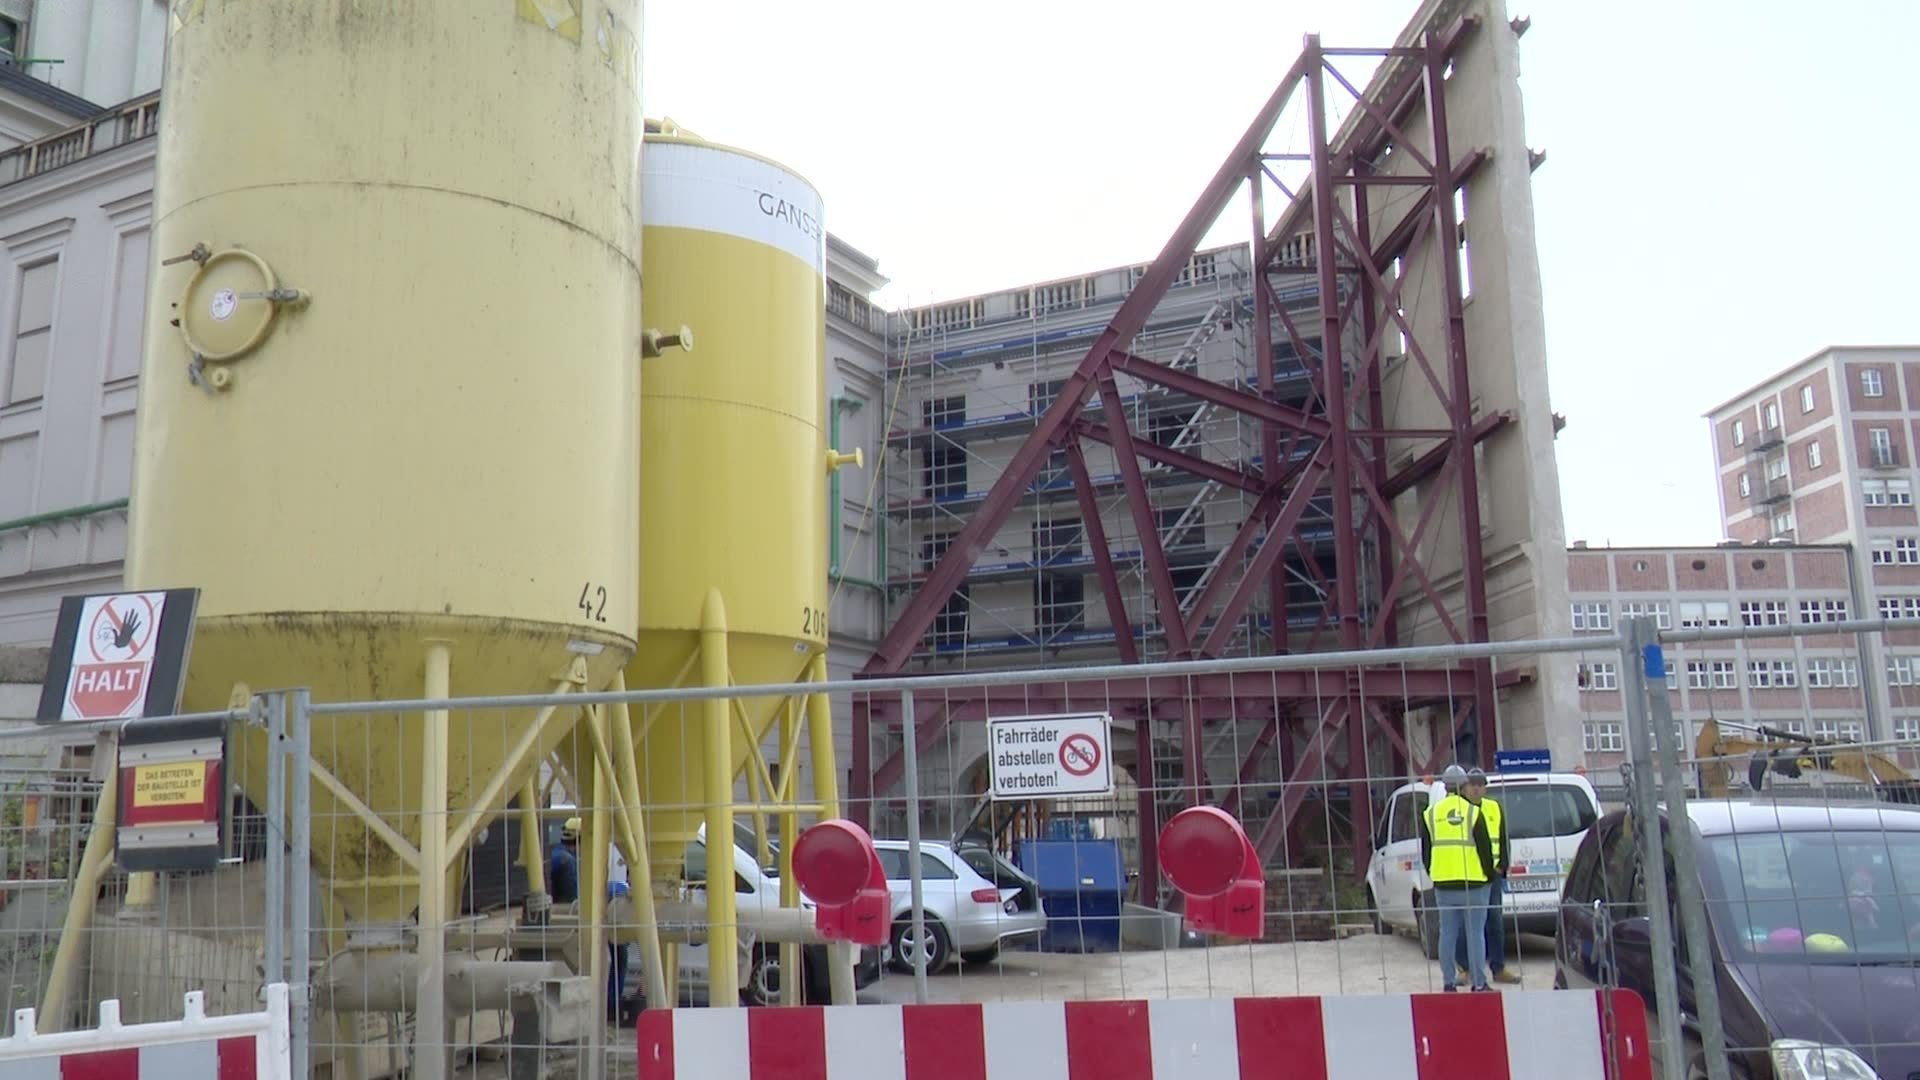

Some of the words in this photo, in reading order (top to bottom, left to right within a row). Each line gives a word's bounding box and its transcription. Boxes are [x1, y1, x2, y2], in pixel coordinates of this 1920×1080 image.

[579, 582, 607, 623] 42
[77, 668, 141, 693] HALT
[997, 726, 1059, 745] Fahrräder
[998, 751, 1055, 767] abstellen
[145, 771, 159, 780] DAS
[160, 768, 194, 779] BETRETEN
[999, 771, 1059, 789] verboten!
[137, 782, 150, 792] DER
[151, 780, 189, 791] BAUSTELLE
[190, 779, 202, 788] IST
